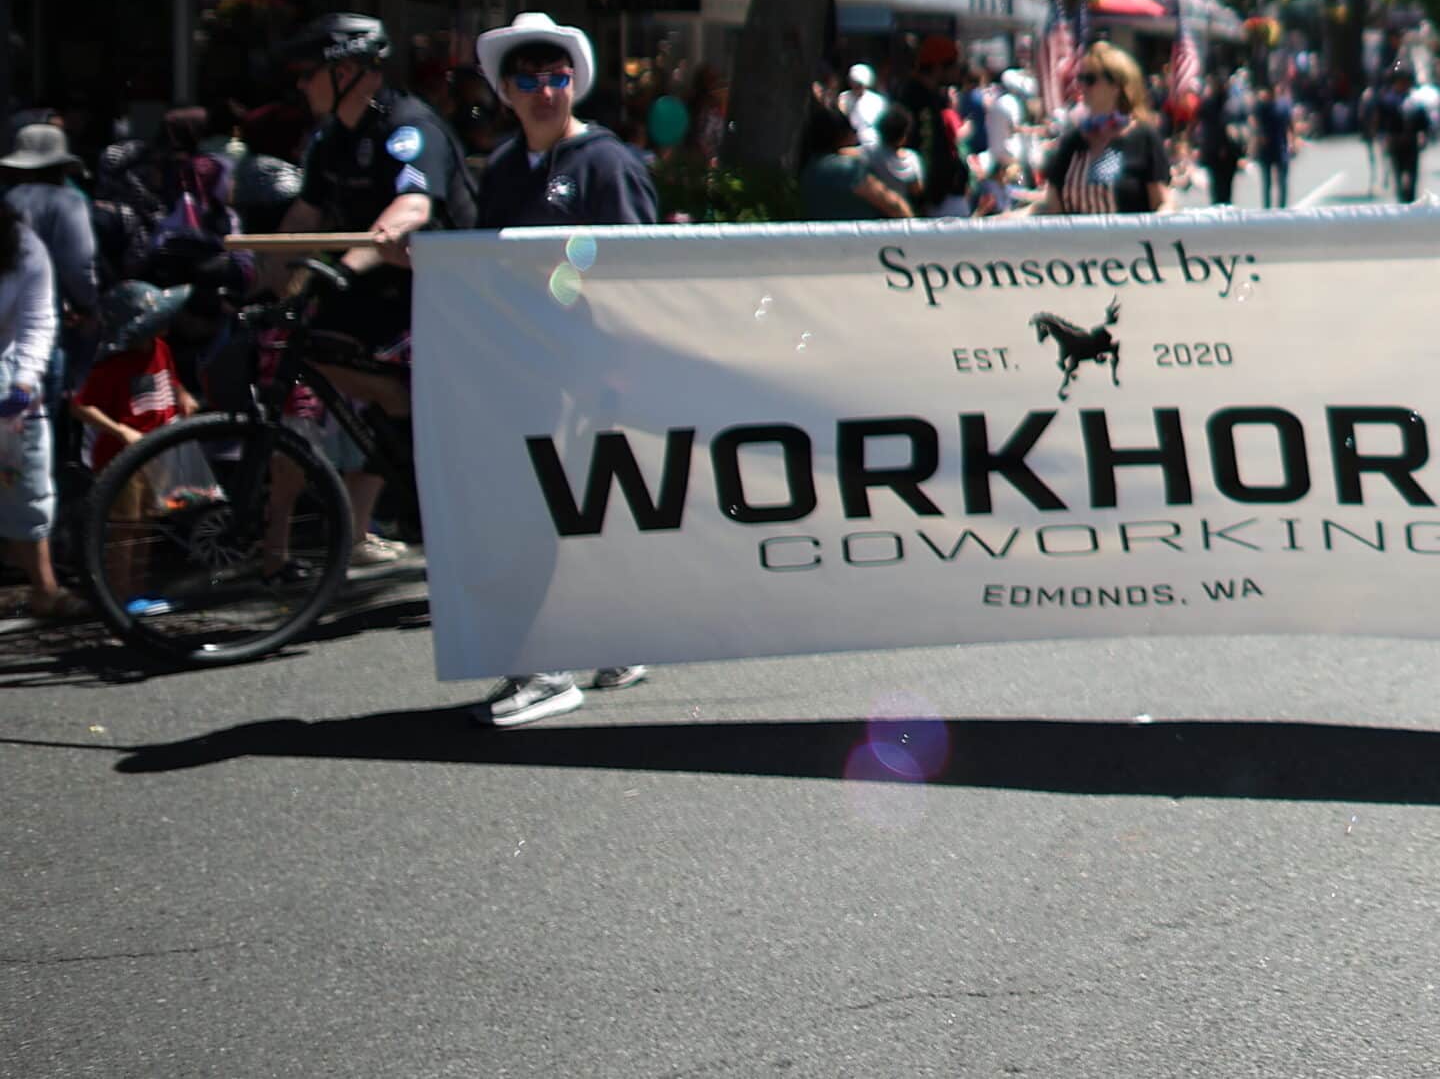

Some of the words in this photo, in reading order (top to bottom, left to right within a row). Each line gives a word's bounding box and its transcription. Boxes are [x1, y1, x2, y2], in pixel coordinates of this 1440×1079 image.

[878, 240, 1165, 307] Sponsored
[1171, 239, 1261, 298] by:
[952, 347, 1020, 372] EST.
[1153, 342, 1234, 367] 2020
[1201, 578, 1264, 600] WA
